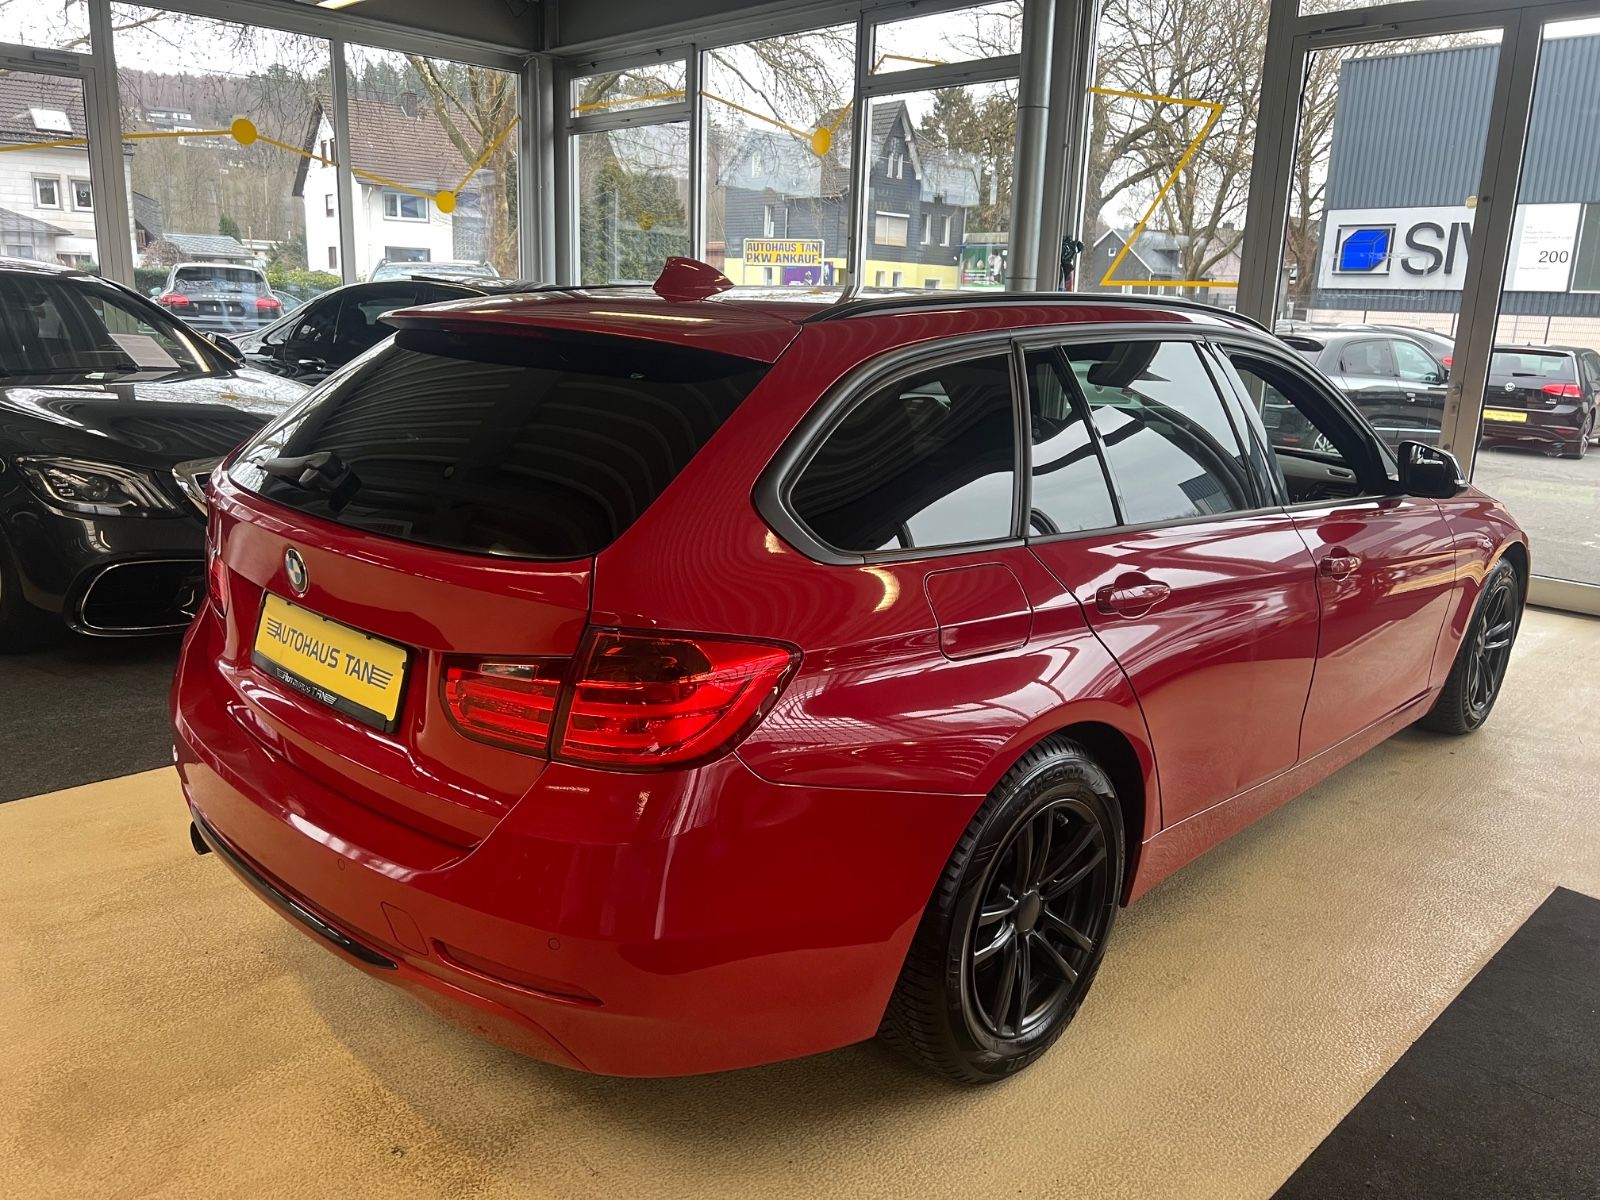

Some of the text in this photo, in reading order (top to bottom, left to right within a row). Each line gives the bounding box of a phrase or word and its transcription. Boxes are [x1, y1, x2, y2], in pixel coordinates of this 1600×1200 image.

[746, 242, 819, 253] AUTOHAUS TAN
[1400, 221, 1472, 276] SI
[746, 253, 818, 264] PKW ANKAUF
[1538, 250, 1569, 264] 200
[273, 622, 376, 685] AUTOHAUS TAN
